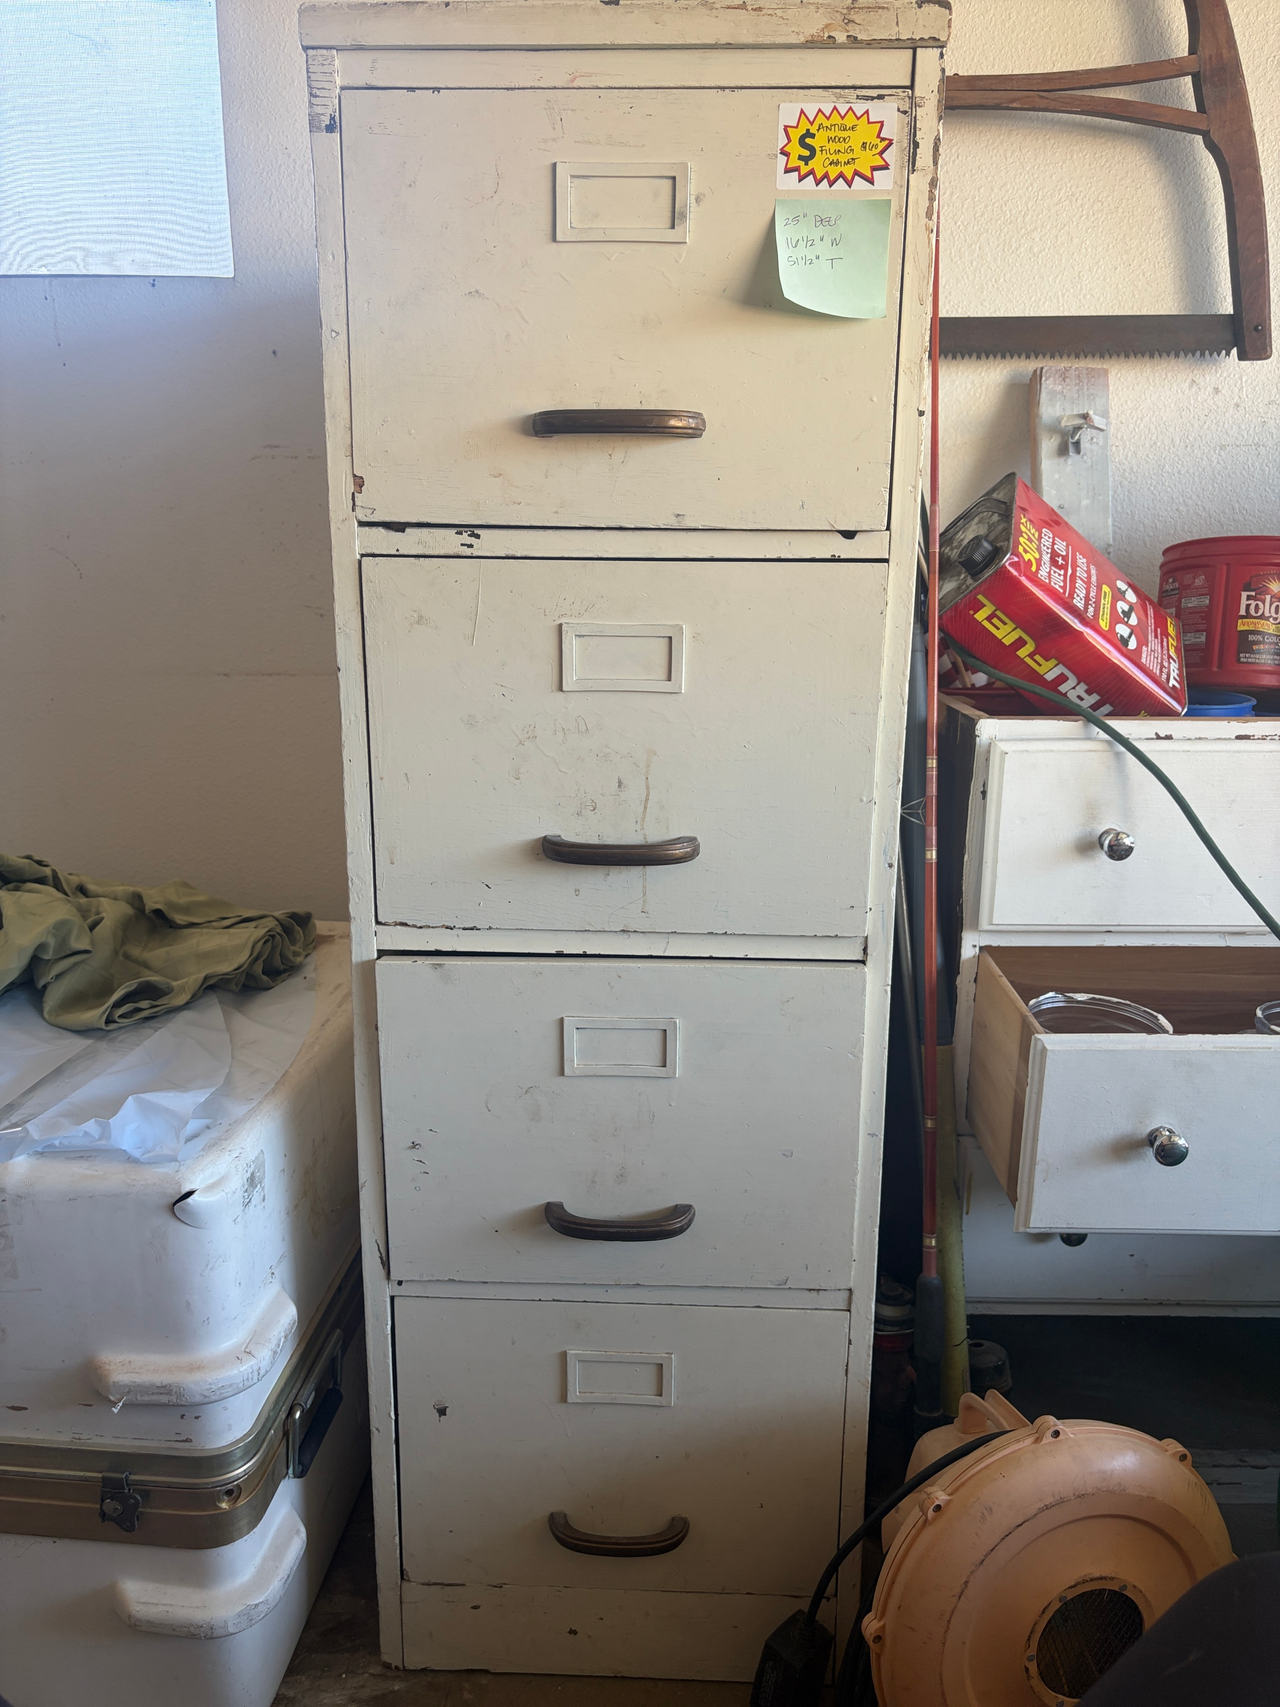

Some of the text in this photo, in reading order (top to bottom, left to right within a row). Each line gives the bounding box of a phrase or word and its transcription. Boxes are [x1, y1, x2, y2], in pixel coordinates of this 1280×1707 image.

[816, 123, 858, 133] ANTIQUE
[797, 129, 816, 166] $
[827, 135, 850, 144] WOOD
[819, 145, 854, 155] FILING
[823, 156, 860, 168] CABINET
[825, 257, 844, 269] T
[1053, 537, 1067, 555] OIL
[1038, 527, 1053, 584] ENGINEERED
[1076, 552, 1087, 571] USE
[1050, 566, 1065, 593] FUEL
[1072, 576, 1087, 610] READY
[973, 594, 1114, 717] TRUFUEL
